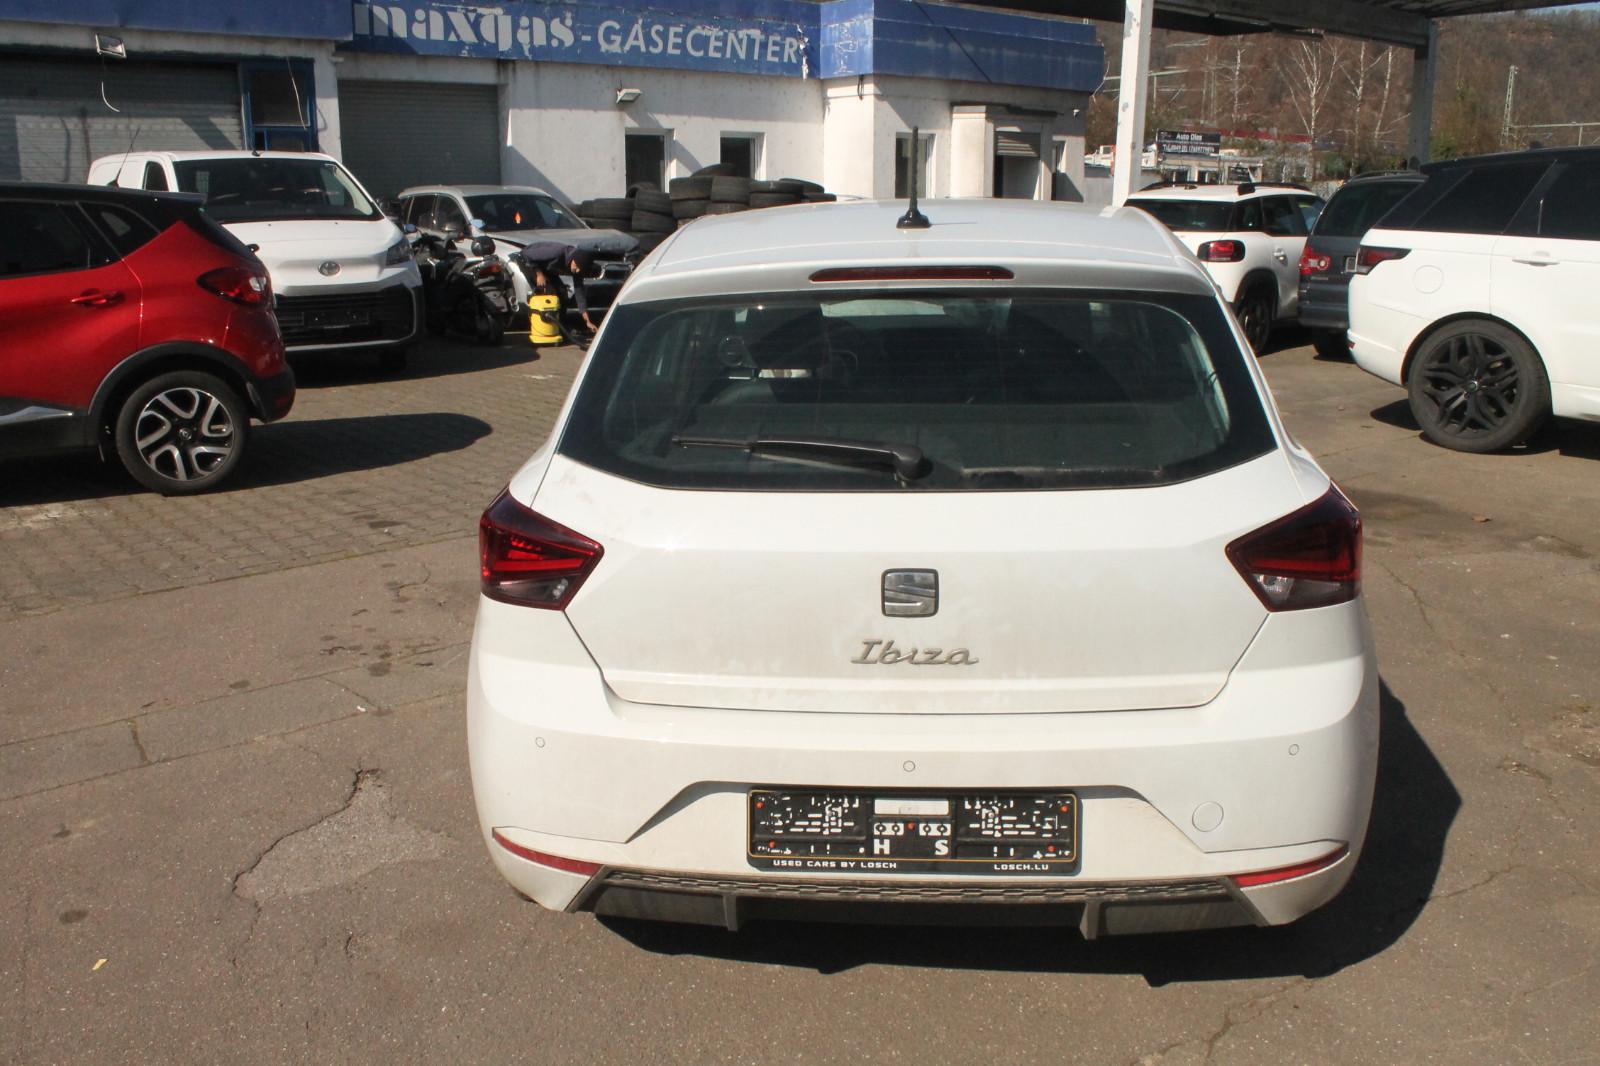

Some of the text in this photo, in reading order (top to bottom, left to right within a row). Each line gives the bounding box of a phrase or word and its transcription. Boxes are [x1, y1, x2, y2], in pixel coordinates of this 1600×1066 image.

[353, 3, 575, 51] maxgas
[597, 20, 801, 63] GASECENTER
[850, 639, 979, 665] Ibiza
[772, 859, 802, 867] USED
[806, 860, 837, 868] CARS
[993, 863, 1049, 871] LOSCH.LU
